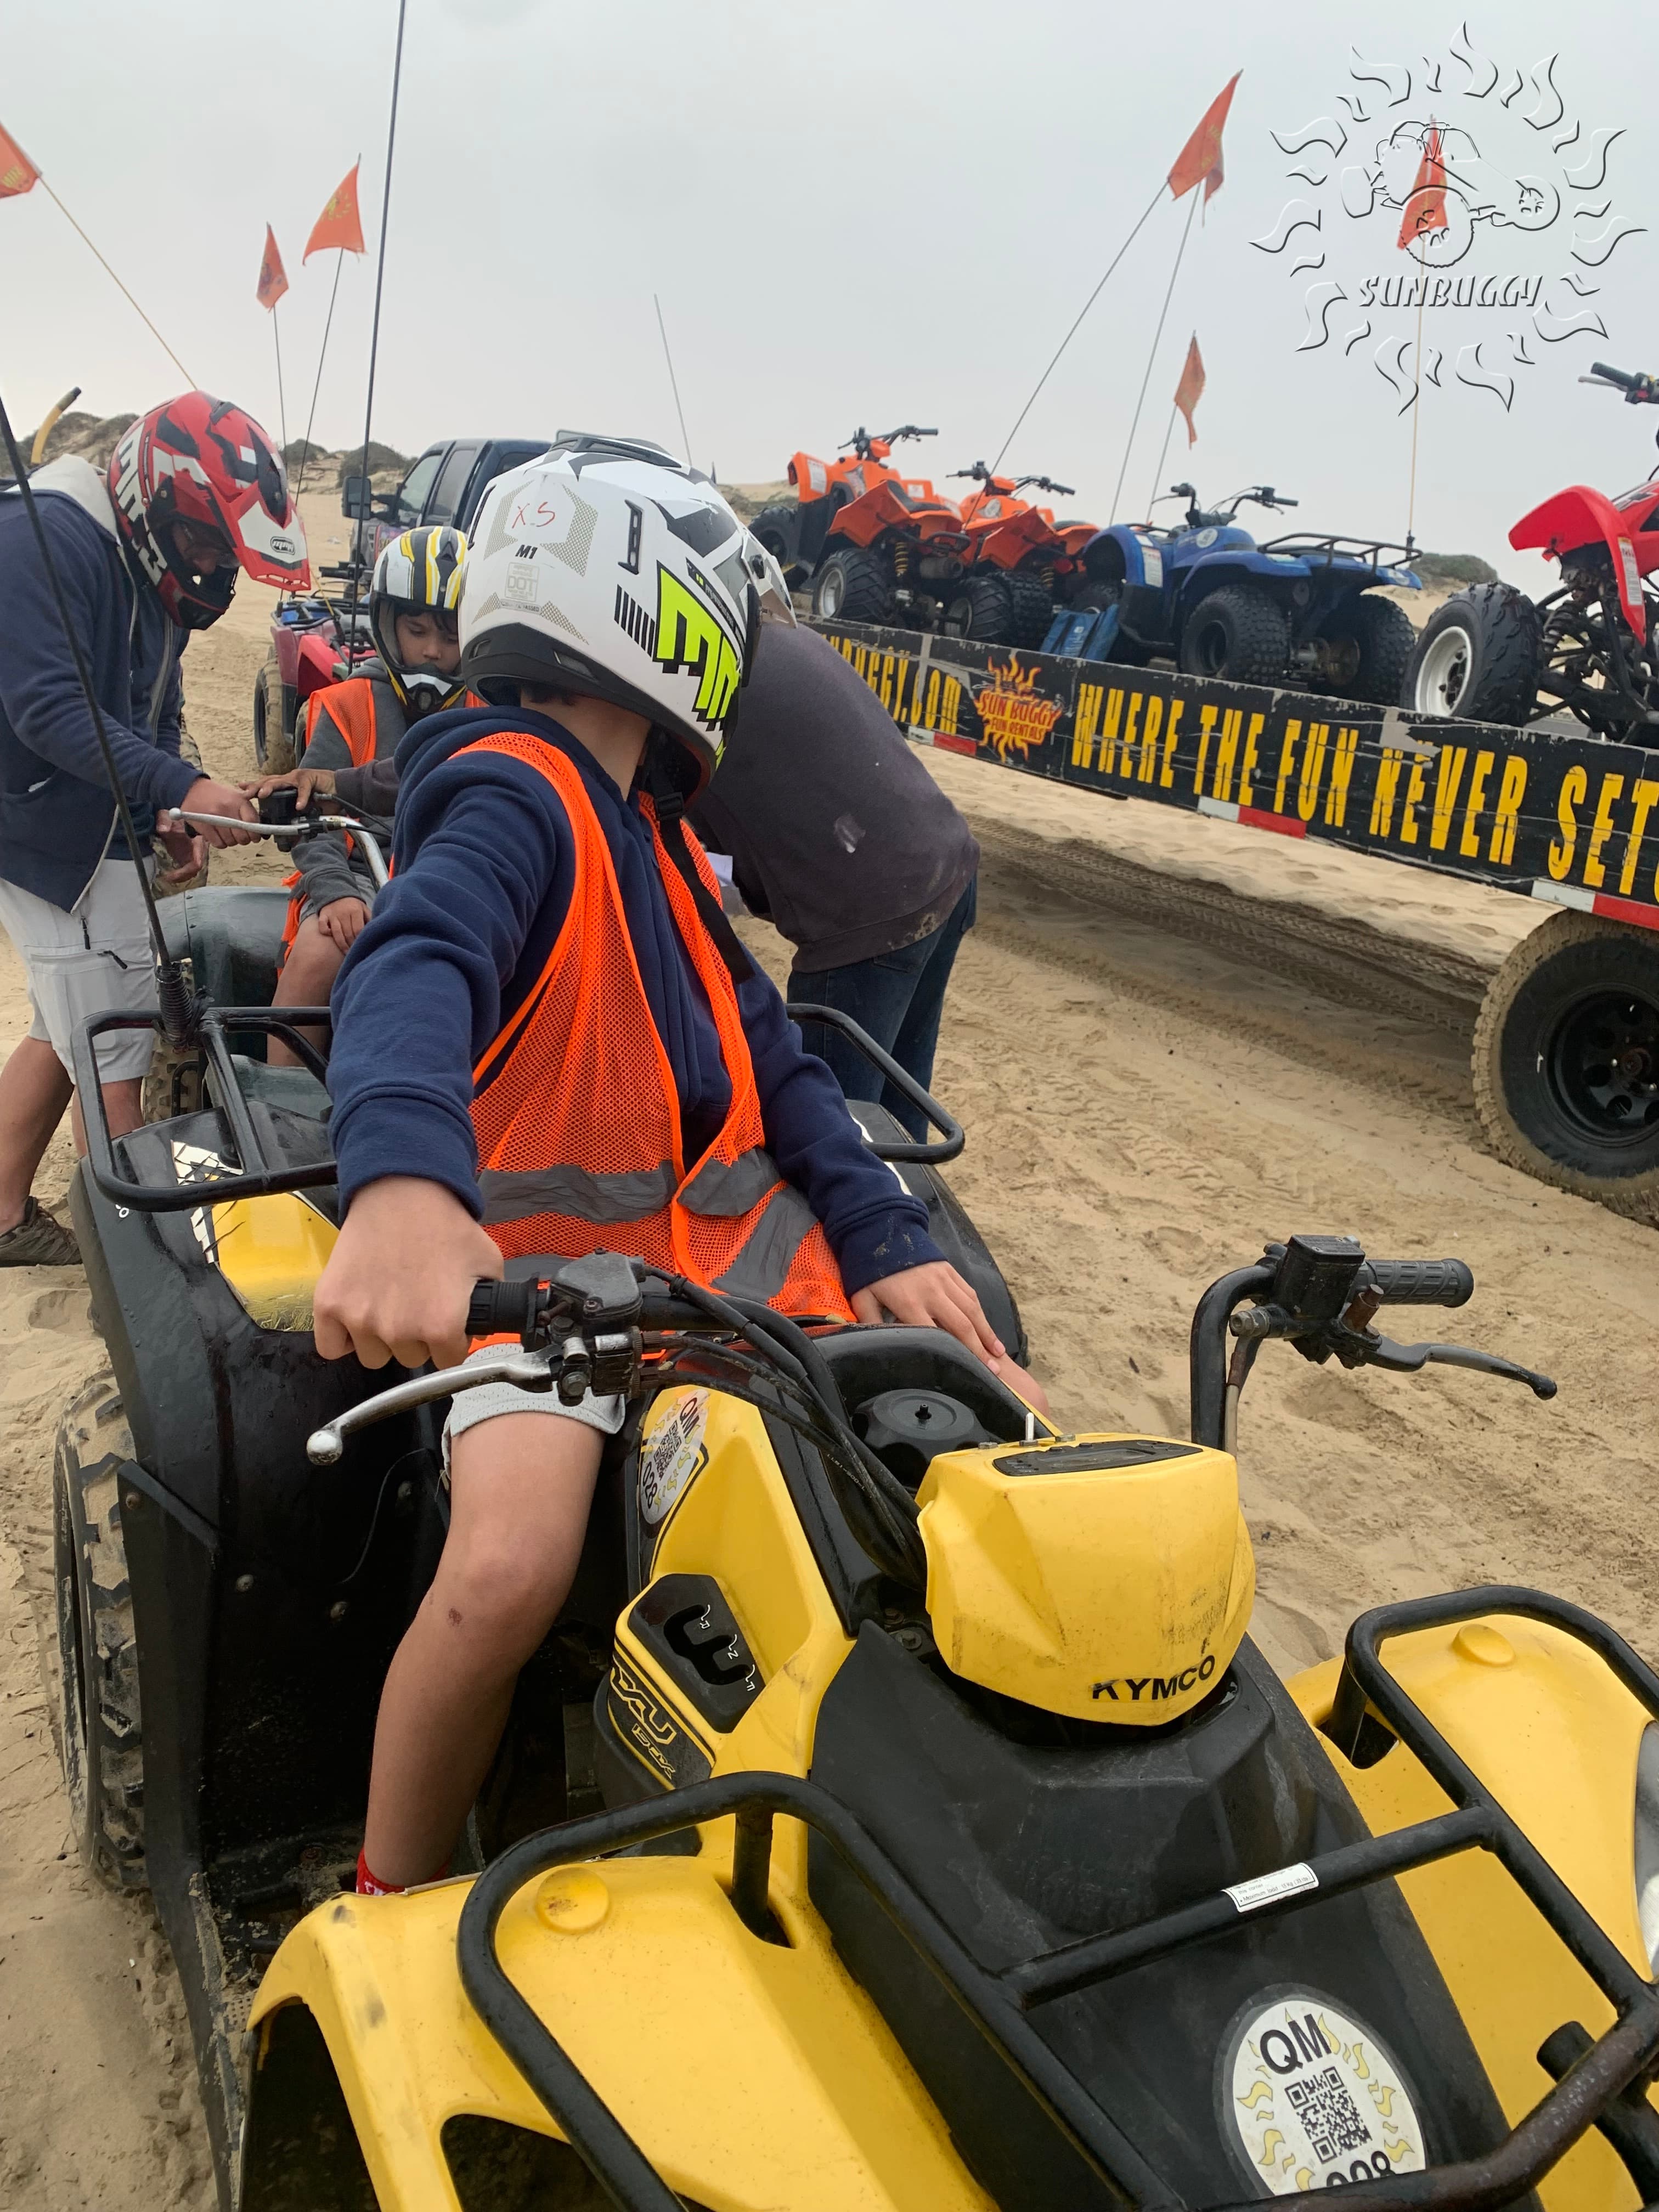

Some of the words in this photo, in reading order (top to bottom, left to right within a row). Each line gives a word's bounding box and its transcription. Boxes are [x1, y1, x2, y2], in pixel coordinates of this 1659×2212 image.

[515, 544, 538, 559] M1
[507, 575, 538, 592] DOT
[980, 693, 1007, 716] SUN
[1010, 701, 1062, 727] BUGGY
[991, 717, 1007, 731] FUN
[1009, 720, 1043, 740] RENTALS
[1071, 682, 1184, 789] WHERE
[1194, 704, 1265, 806] THE
[1273, 719, 1359, 827] FUN
[1369, 742, 1528, 866] NEVER
[1548, 765, 1659, 904] SET
[680, 1397, 700, 1439] QM
[642, 1461, 658, 1509] 028
[1091, 1655, 1216, 1701] KYMCO
[1242, 1891, 1266, 1901] Maximum
[1259, 2013, 1332, 2075] QM
